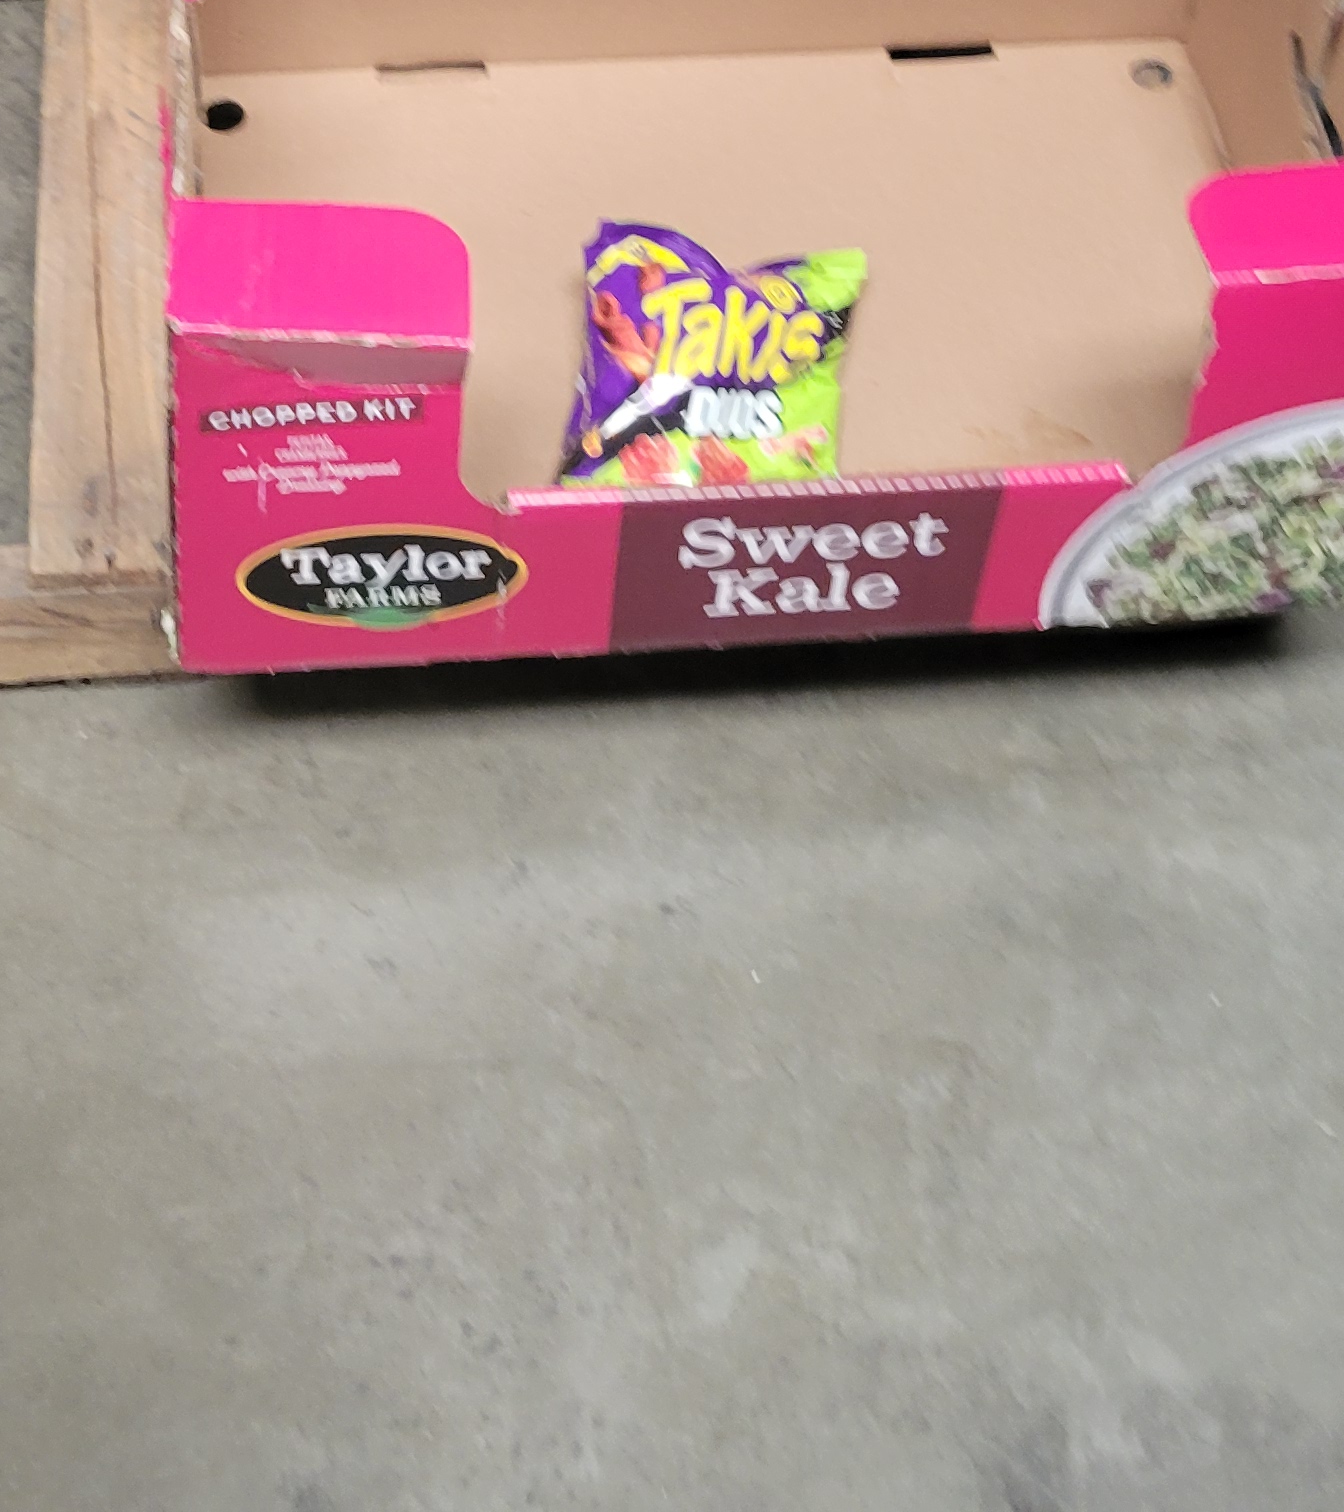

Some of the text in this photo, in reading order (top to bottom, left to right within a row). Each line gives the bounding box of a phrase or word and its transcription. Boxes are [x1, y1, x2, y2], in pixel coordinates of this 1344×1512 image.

[208, 396, 417, 432] CHOPPED KIT
[677, 511, 950, 570] Sweet
[280, 543, 493, 589] Taylor
[323, 583, 443, 610] FARMS
[702, 560, 901, 619] Kale
